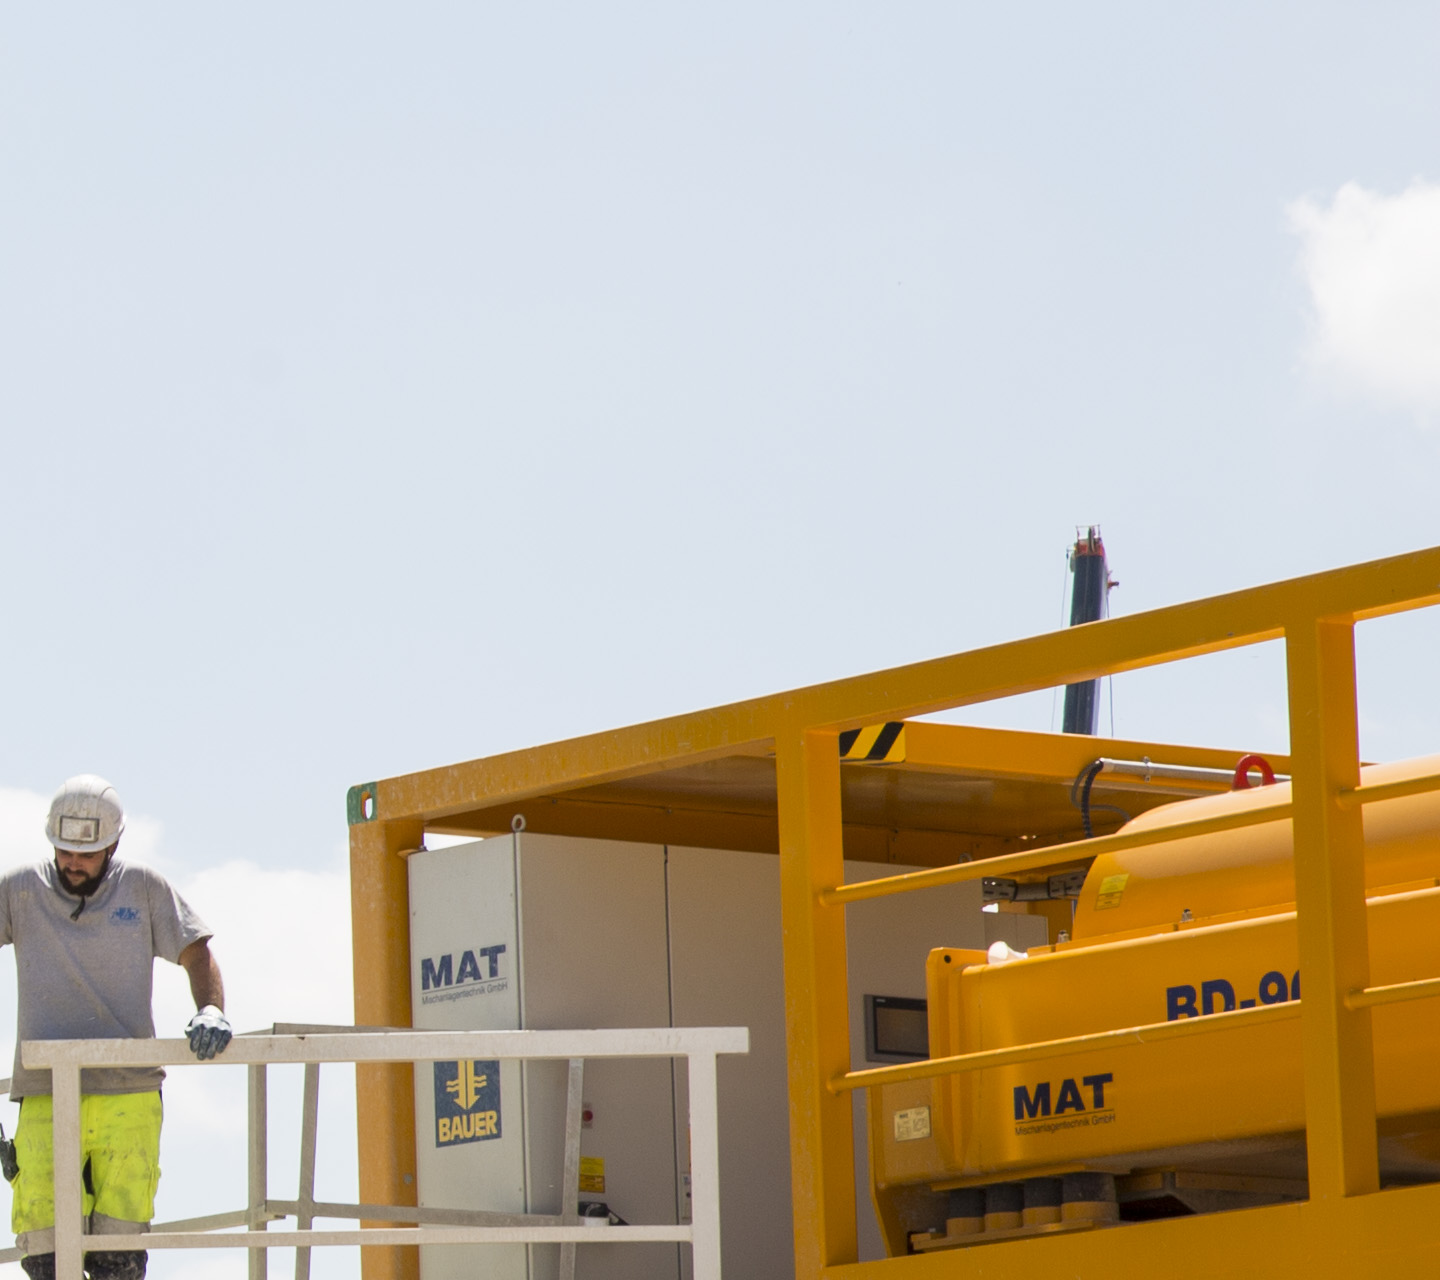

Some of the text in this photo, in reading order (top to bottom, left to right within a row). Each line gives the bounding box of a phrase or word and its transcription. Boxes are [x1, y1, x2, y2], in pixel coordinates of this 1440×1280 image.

[421, 943, 507, 991] MAT
[1013, 1072, 1114, 1120] MAT
[438, 1110, 498, 1143] BAUER
